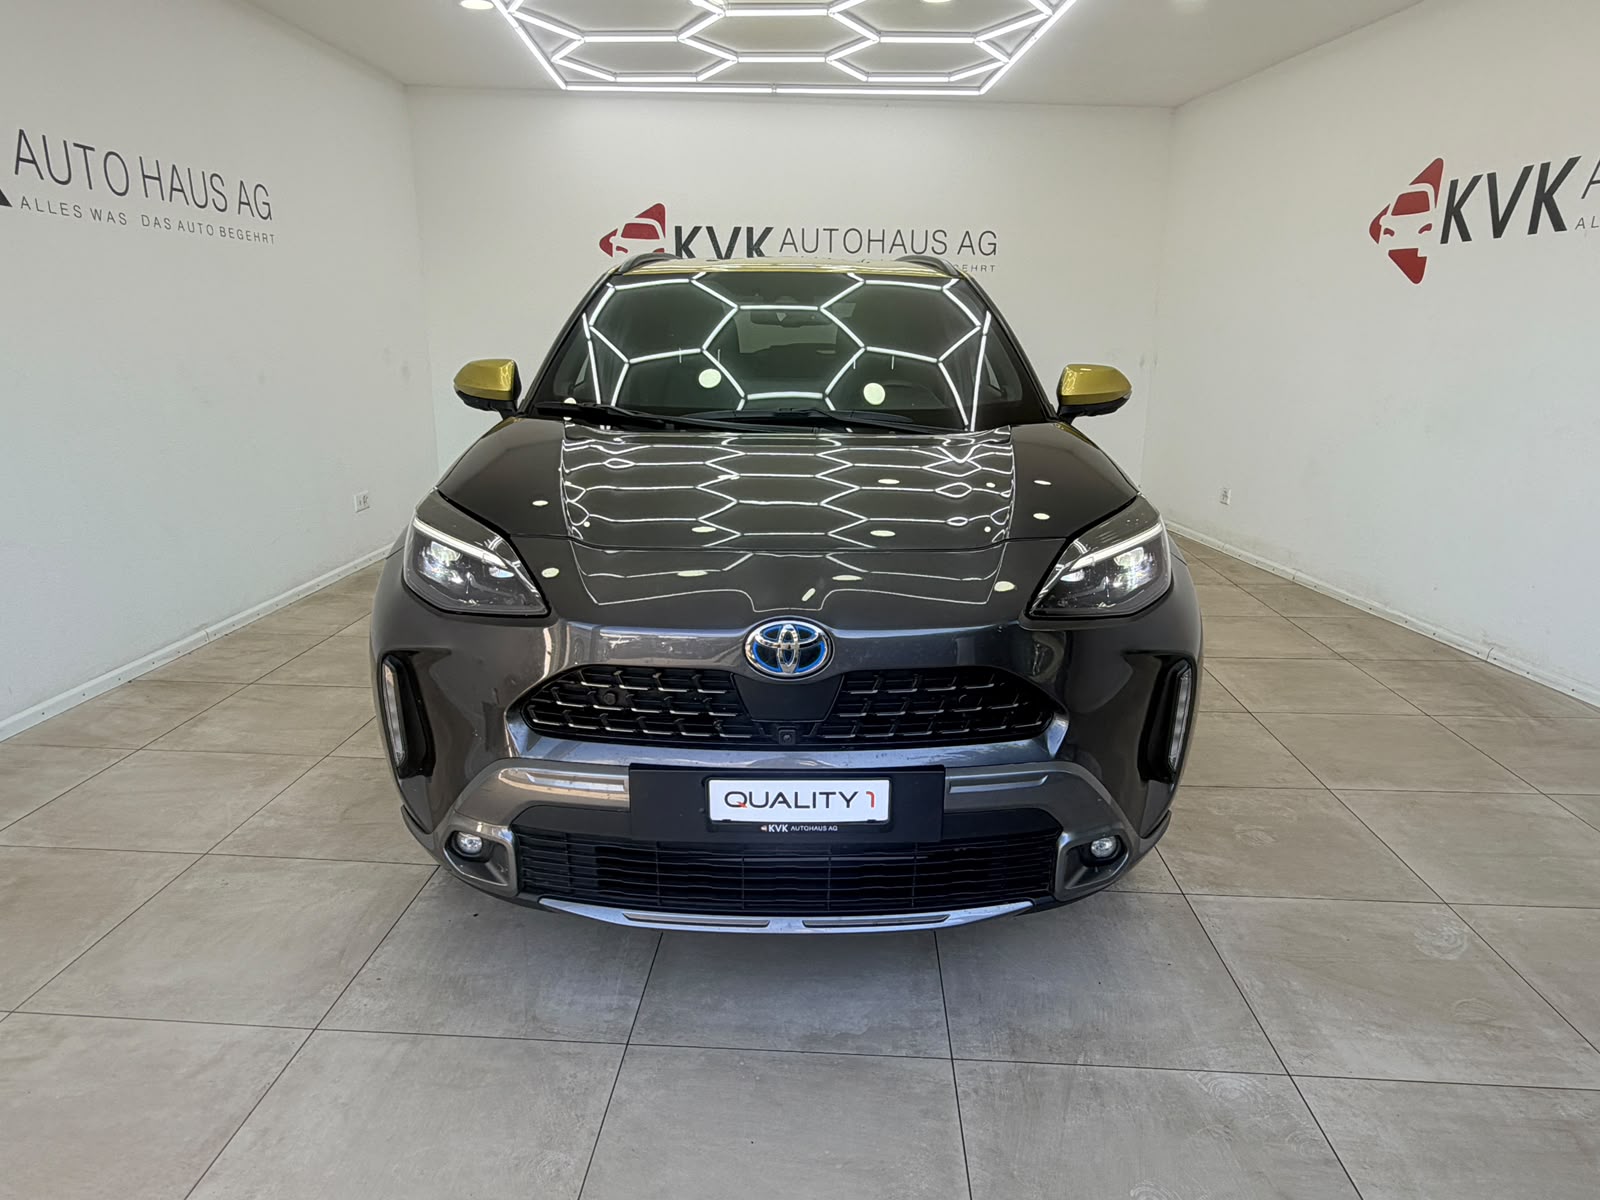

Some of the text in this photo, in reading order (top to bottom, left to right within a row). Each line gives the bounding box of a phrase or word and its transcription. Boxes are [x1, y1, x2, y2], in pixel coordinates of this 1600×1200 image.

[237, 180, 273, 221] AG
[1439, 155, 1583, 245] KVK
[20, 195, 83, 219] ALLES
[90, 207, 128, 226] WAS
[140, 214, 172, 231] DAS
[177, 219, 215, 237] AUTO
[218, 225, 276, 246] BEGEHRT
[674, 225, 998, 260] KVK AUTOHAUS AG
[954, 263, 997, 273] EHRT
[724, 791, 876, 809] QUALITY 1
[768, 824, 789, 833] KVK
